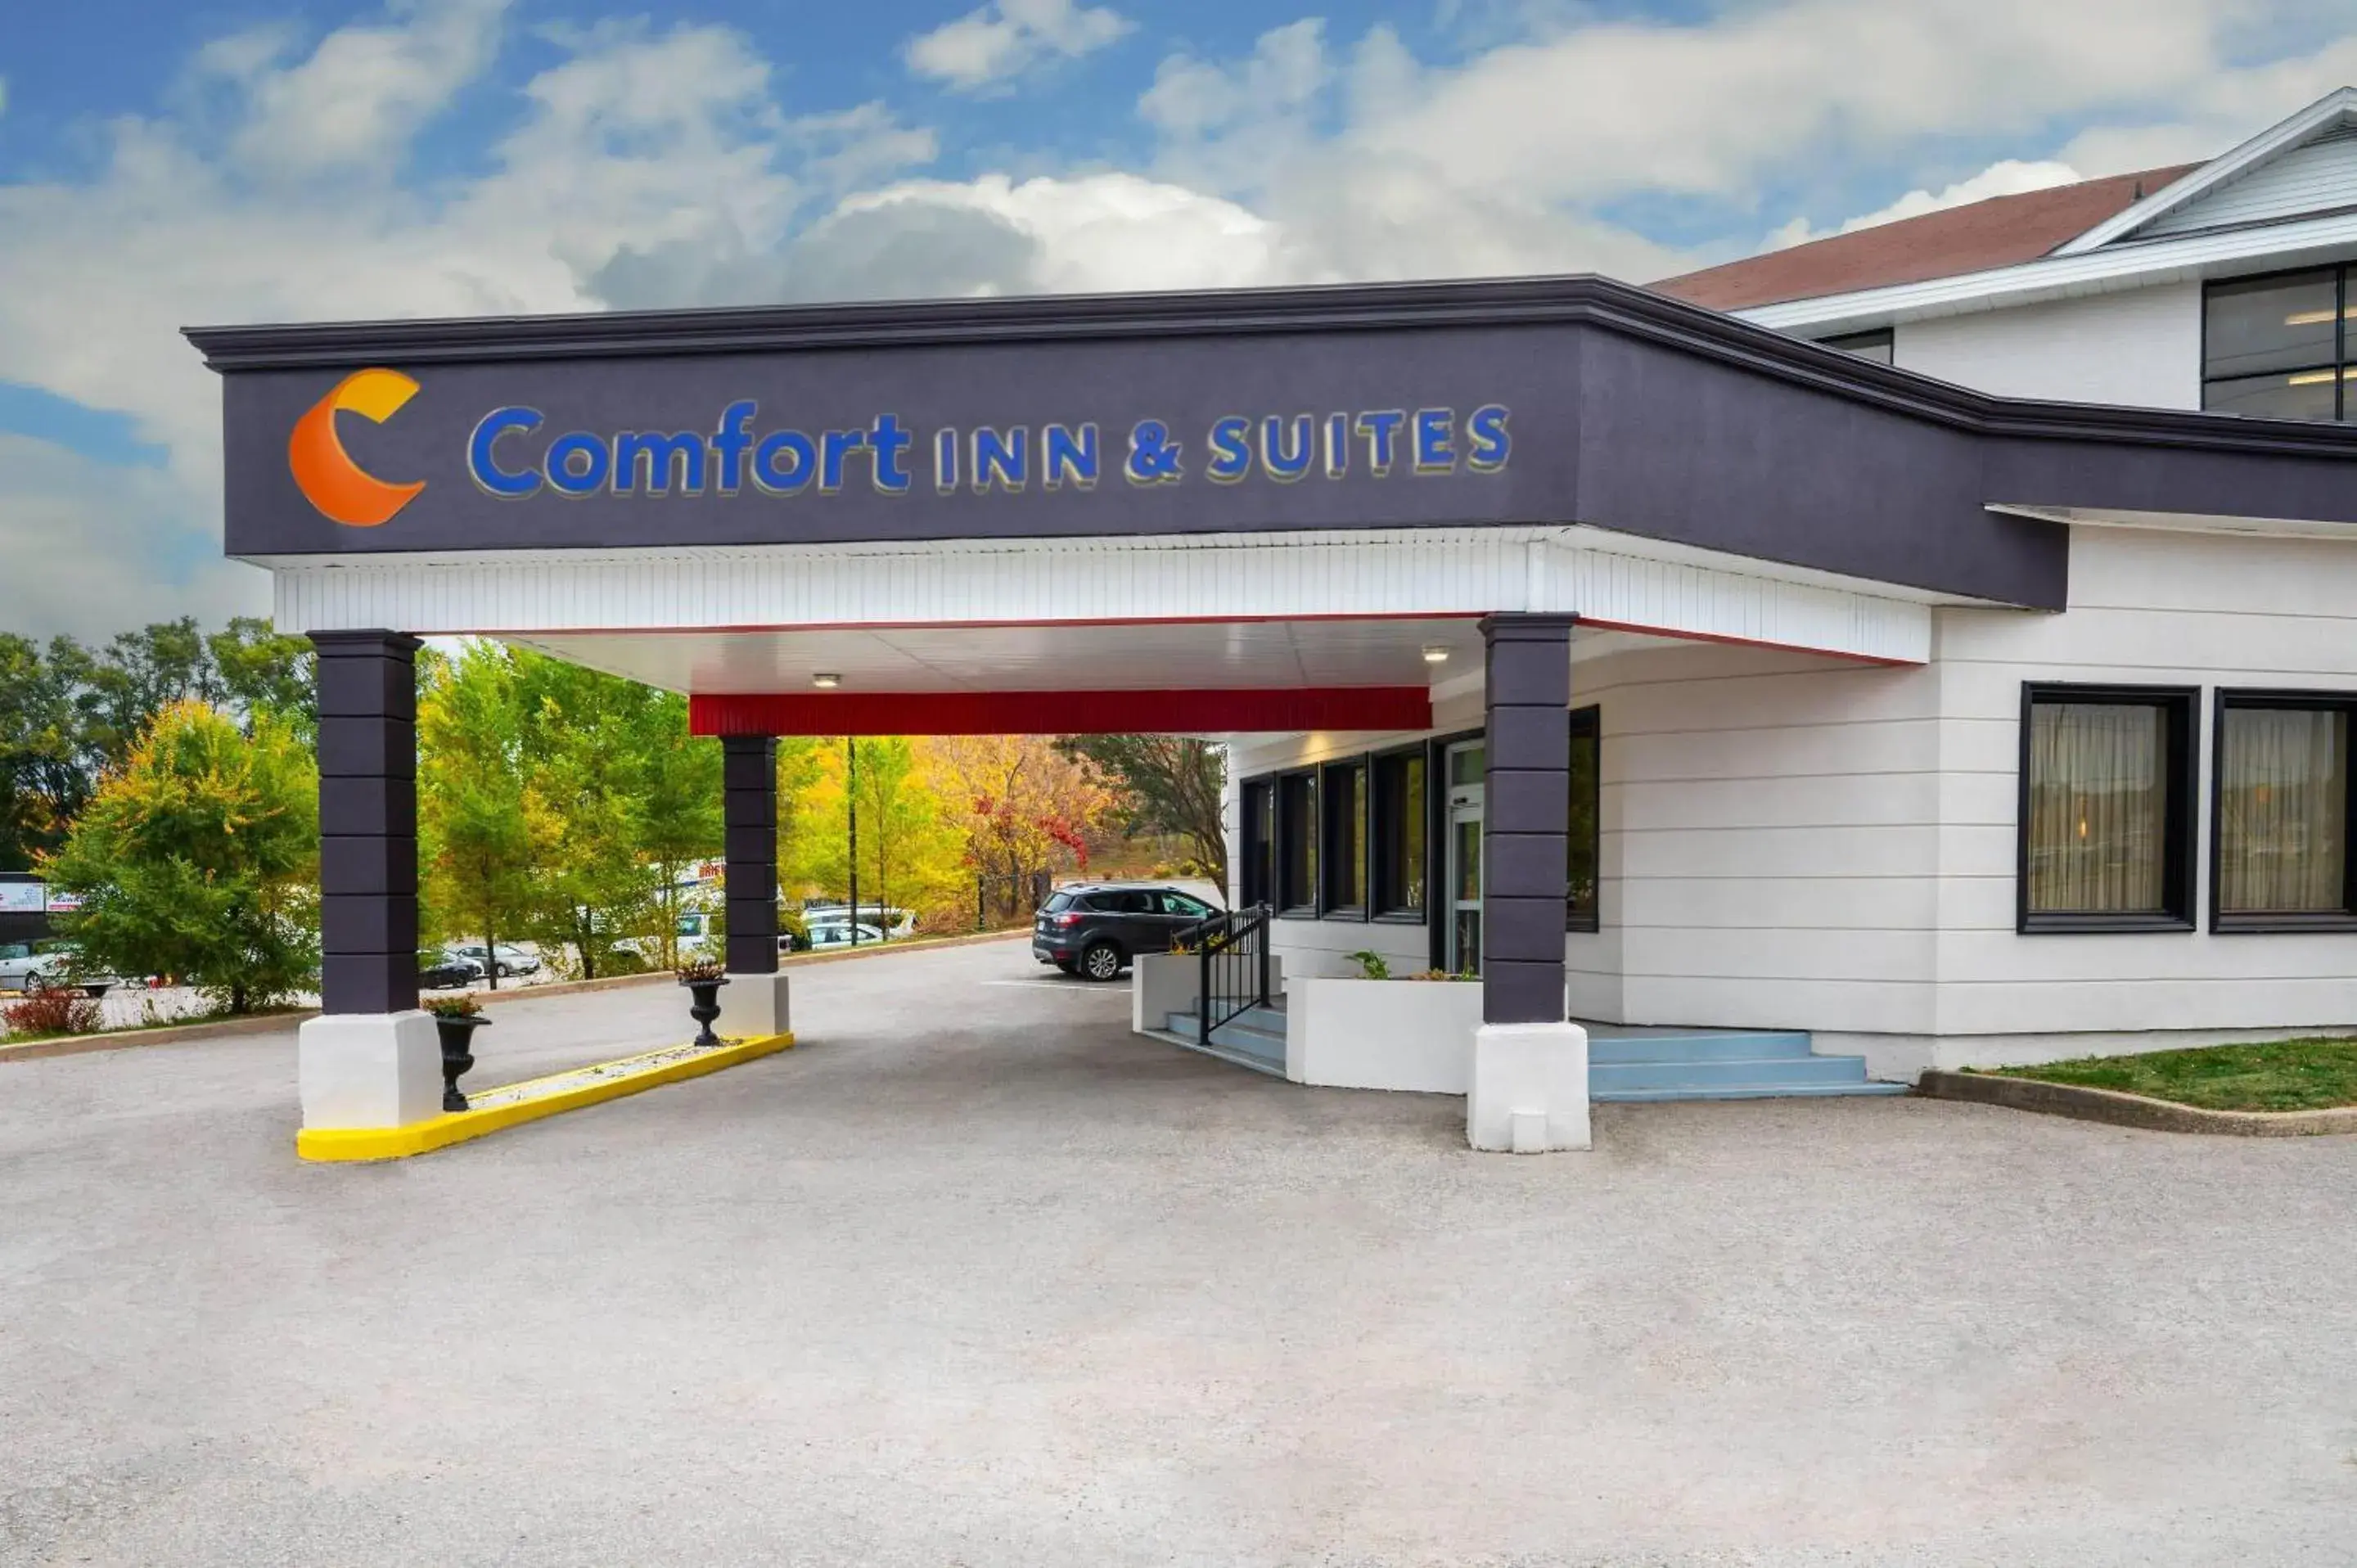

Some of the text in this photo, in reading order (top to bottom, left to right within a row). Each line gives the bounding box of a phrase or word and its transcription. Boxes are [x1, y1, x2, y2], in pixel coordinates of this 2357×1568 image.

[468, 401, 1512, 498] Comfort INN & SUITES
